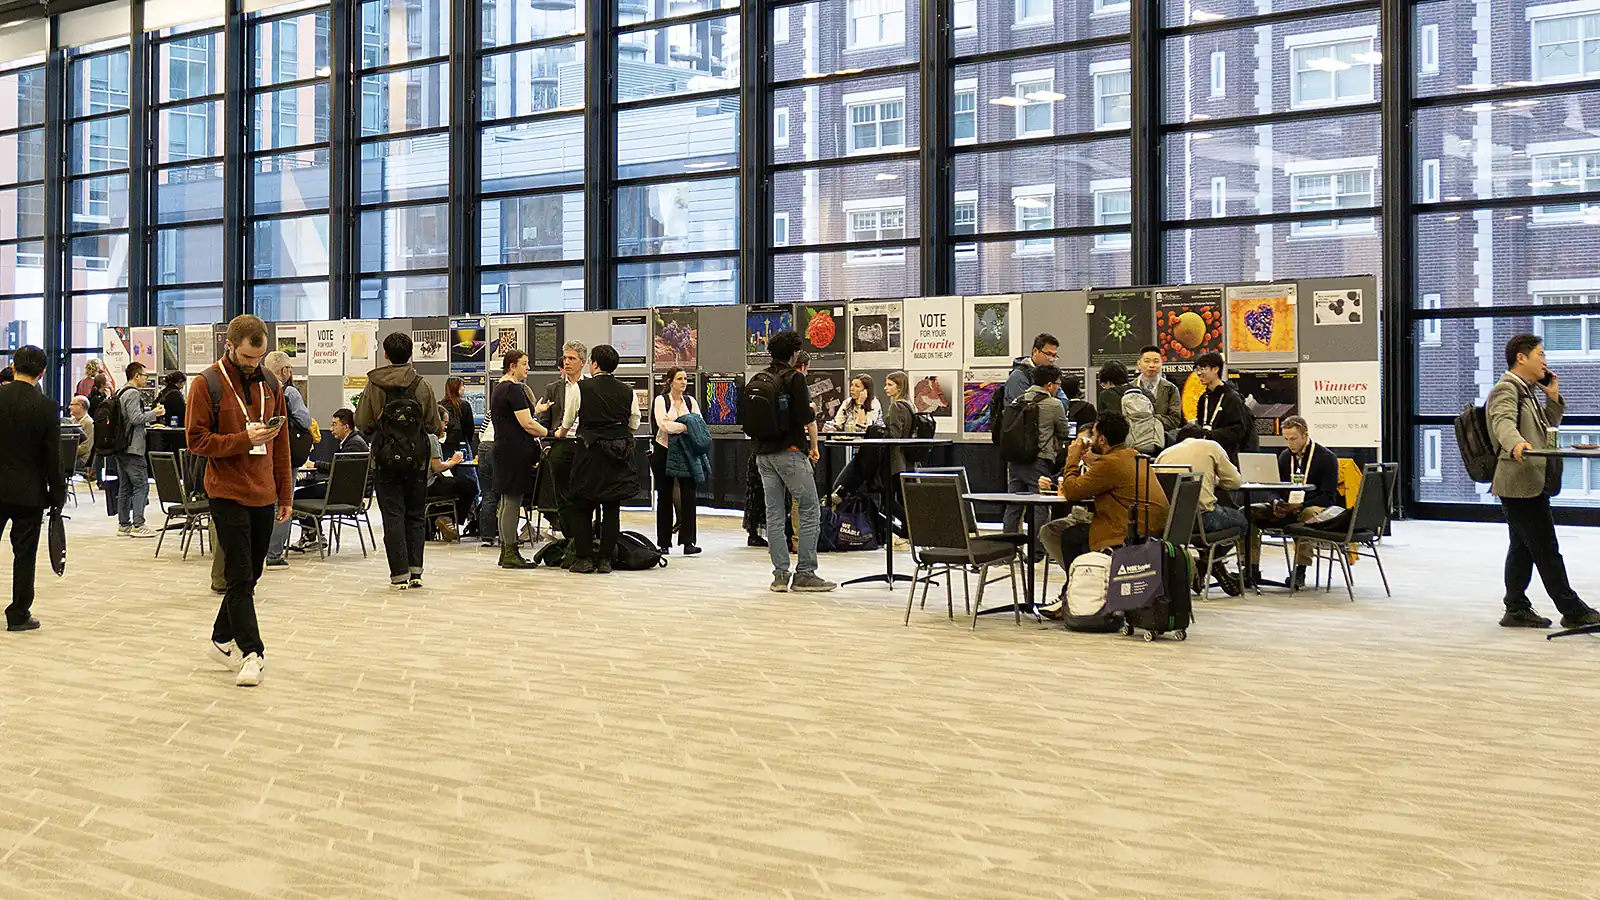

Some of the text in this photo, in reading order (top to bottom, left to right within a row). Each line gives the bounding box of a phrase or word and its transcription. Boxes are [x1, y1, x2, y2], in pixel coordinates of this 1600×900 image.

[920, 314, 947, 327] VOTE
[317, 329, 334, 340] VOTE
[911, 338, 955, 353] favorite
[312, 349, 339, 359] favorite
[1162, 364, 1194, 373] THE SUN
[1314, 380, 1368, 391] Winners
[1314, 396, 1366, 405] ANNOUNCED
